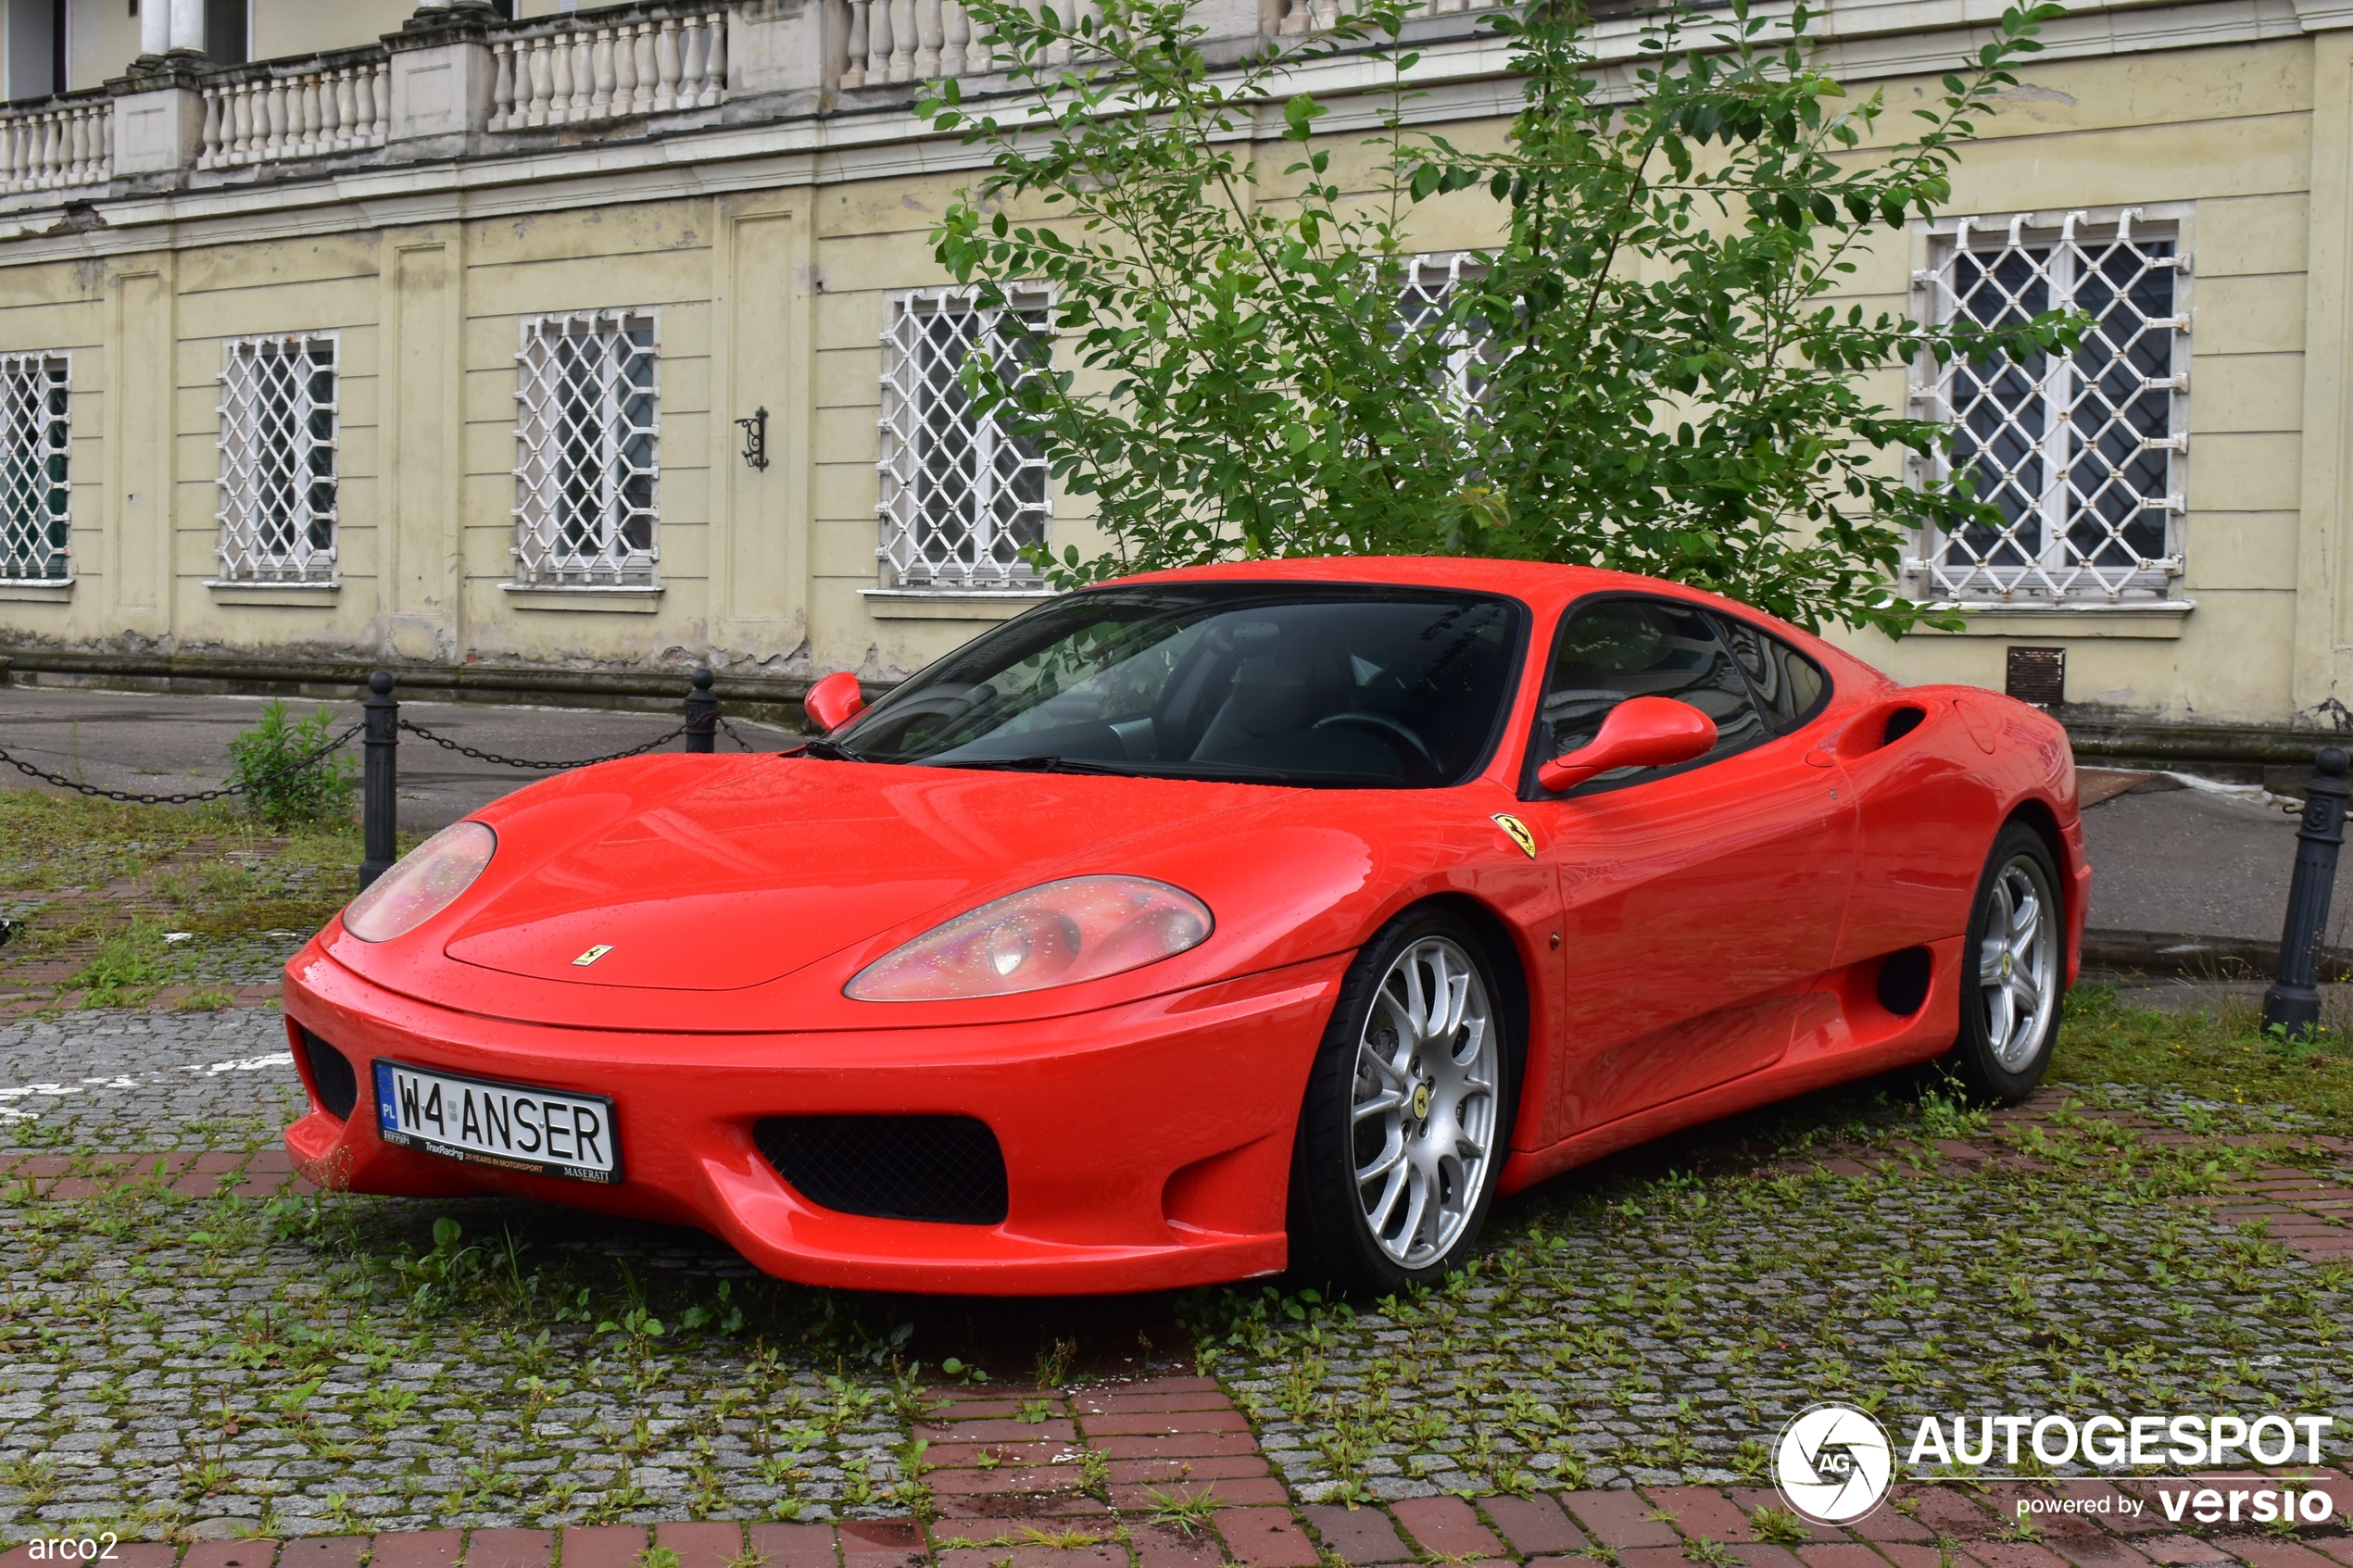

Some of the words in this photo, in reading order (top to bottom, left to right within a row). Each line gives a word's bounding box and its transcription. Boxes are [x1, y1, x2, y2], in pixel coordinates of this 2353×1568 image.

[383, 1103, 396, 1120] PL
[398, 1073, 445, 1136] W4
[462, 1087, 604, 1163] ANSER
[384, 1130, 409, 1145] Ferrari
[425, 1142, 463, 1160] TraxRacing
[499, 1159, 544, 1173] MOTORSPORT
[564, 1167, 609, 1181] MASERATI
